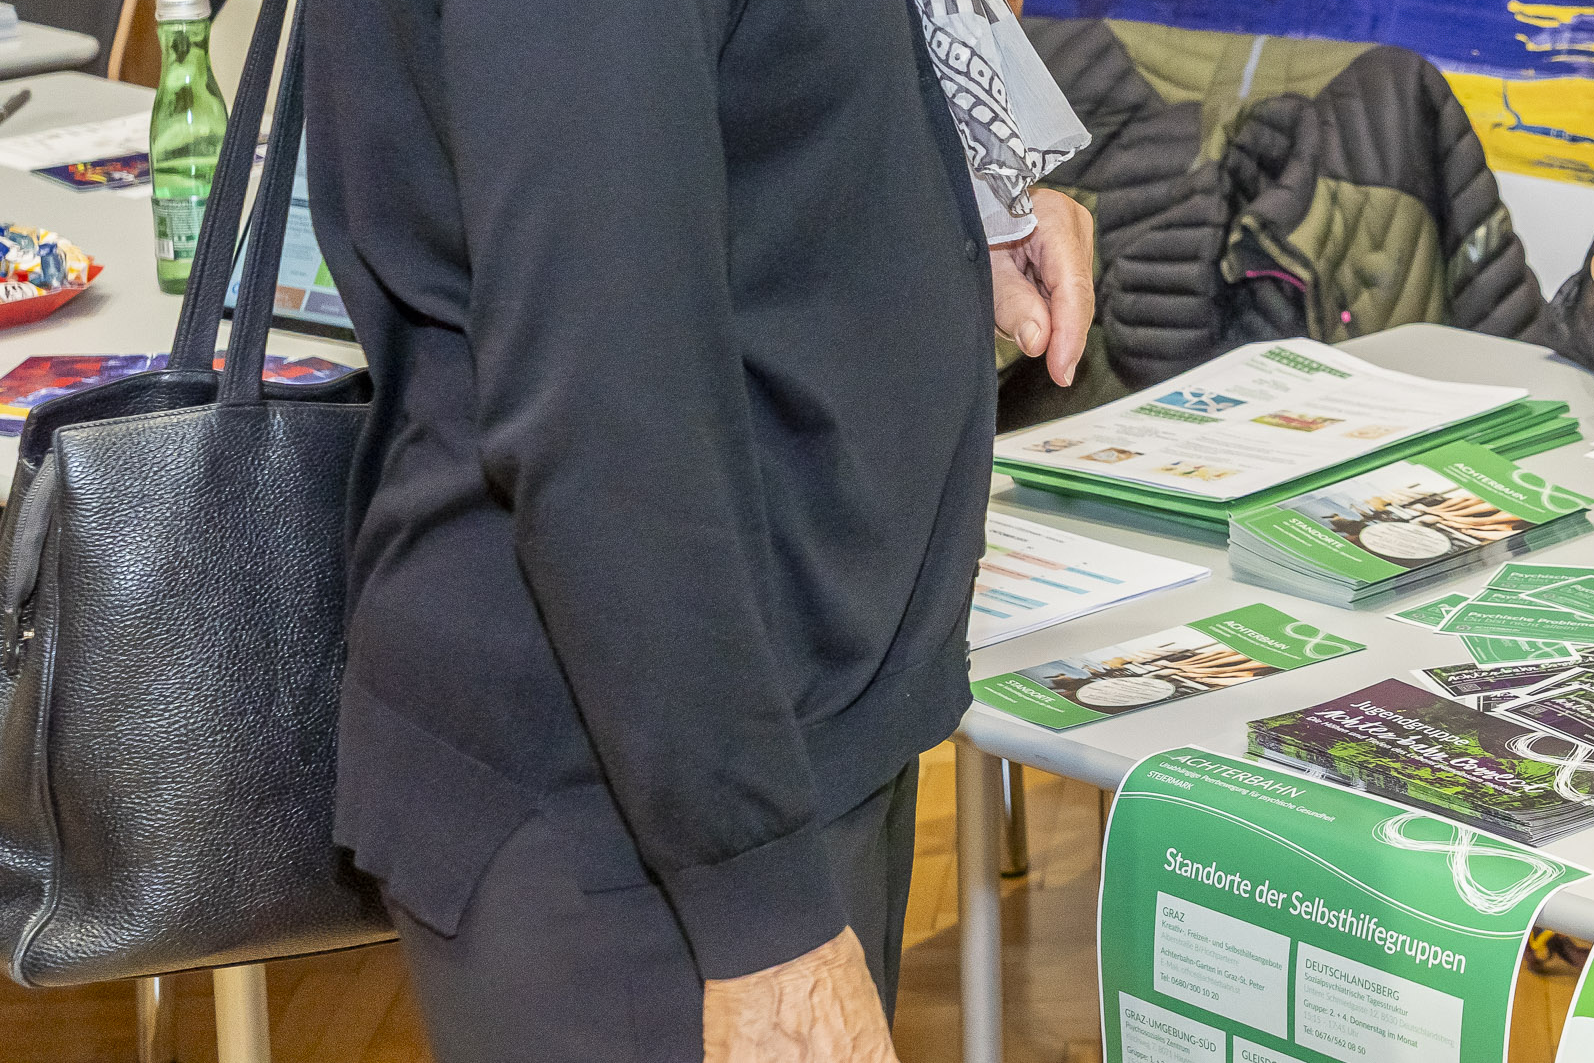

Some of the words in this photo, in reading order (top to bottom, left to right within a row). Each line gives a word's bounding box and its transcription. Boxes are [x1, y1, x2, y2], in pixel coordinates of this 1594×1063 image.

[1289, 518, 1345, 548] STANDORTE
[1350, 700, 1470, 747] Jugendgruppe
[1147, 770, 1194, 791] STEIERMARK
[1159, 762, 1202, 779] Unabhängige
[1200, 774, 1250, 795] Peerbewegung
[1258, 795, 1296, 811] psychische
[1296, 806, 1335, 822] Gesundheit
[1174, 755, 1306, 799] ACHTERBAHN
[1162, 906, 1185, 922] GRAZ
[1163, 847, 1251, 898] Standorte
[1255, 880, 1287, 909] der
[1289, 890, 1467, 974] Selbsthilfegruppen
[1202, 988, 1210, 997] 10
[1211, 991, 1219, 1000] 20
[1248, 979, 1265, 992] Peter
[1305, 958, 1400, 1001] DEUTSCHLANDSBERG
[1124, 1008, 1217, 1052] GRAZ-UMGEBUNG-SÜD
[1398, 1034, 1418, 1048] Monat
[1357, 1045, 1366, 1055] 50
